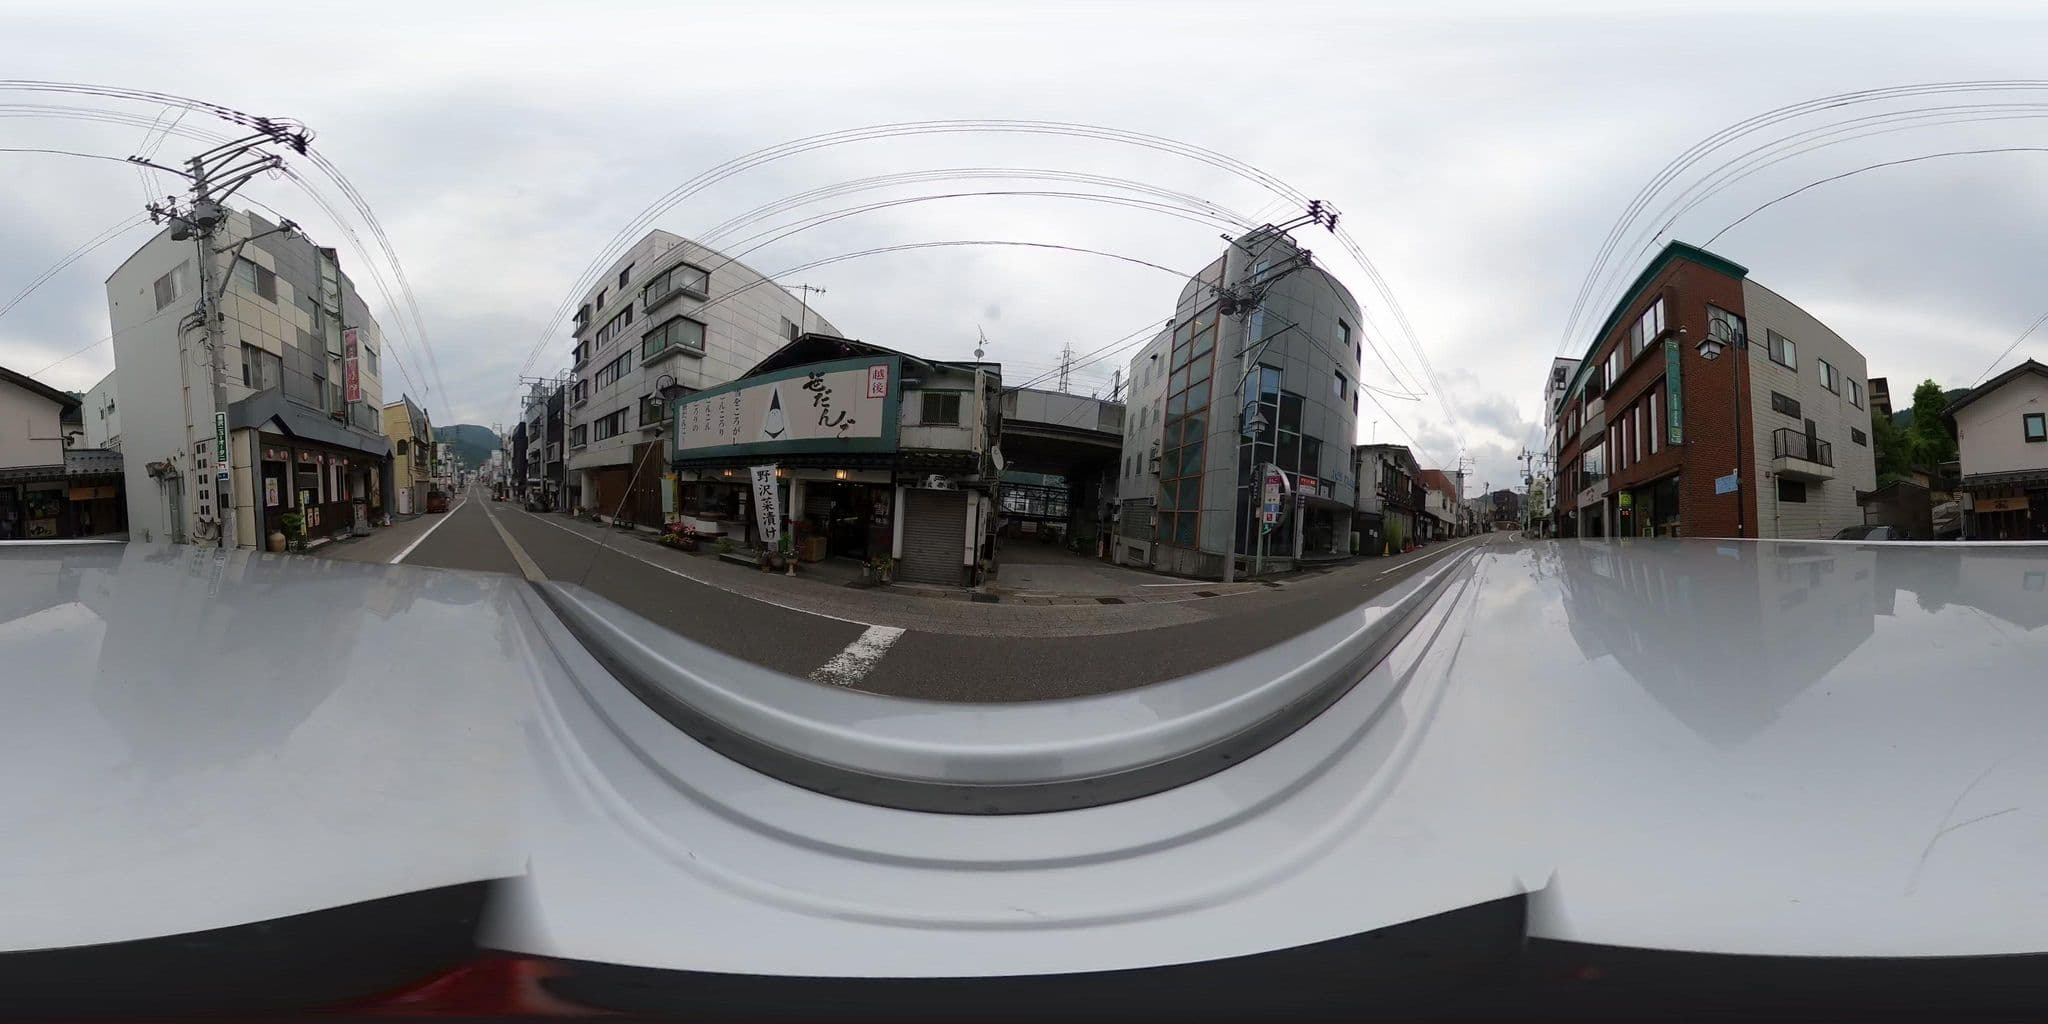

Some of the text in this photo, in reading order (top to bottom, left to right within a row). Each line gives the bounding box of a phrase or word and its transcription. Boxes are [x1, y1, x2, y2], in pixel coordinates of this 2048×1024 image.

[803, 371, 856, 440] 笹だんご
[872, 368, 885, 394] 越後
[756, 469, 777, 539] 野沢菜漬け
